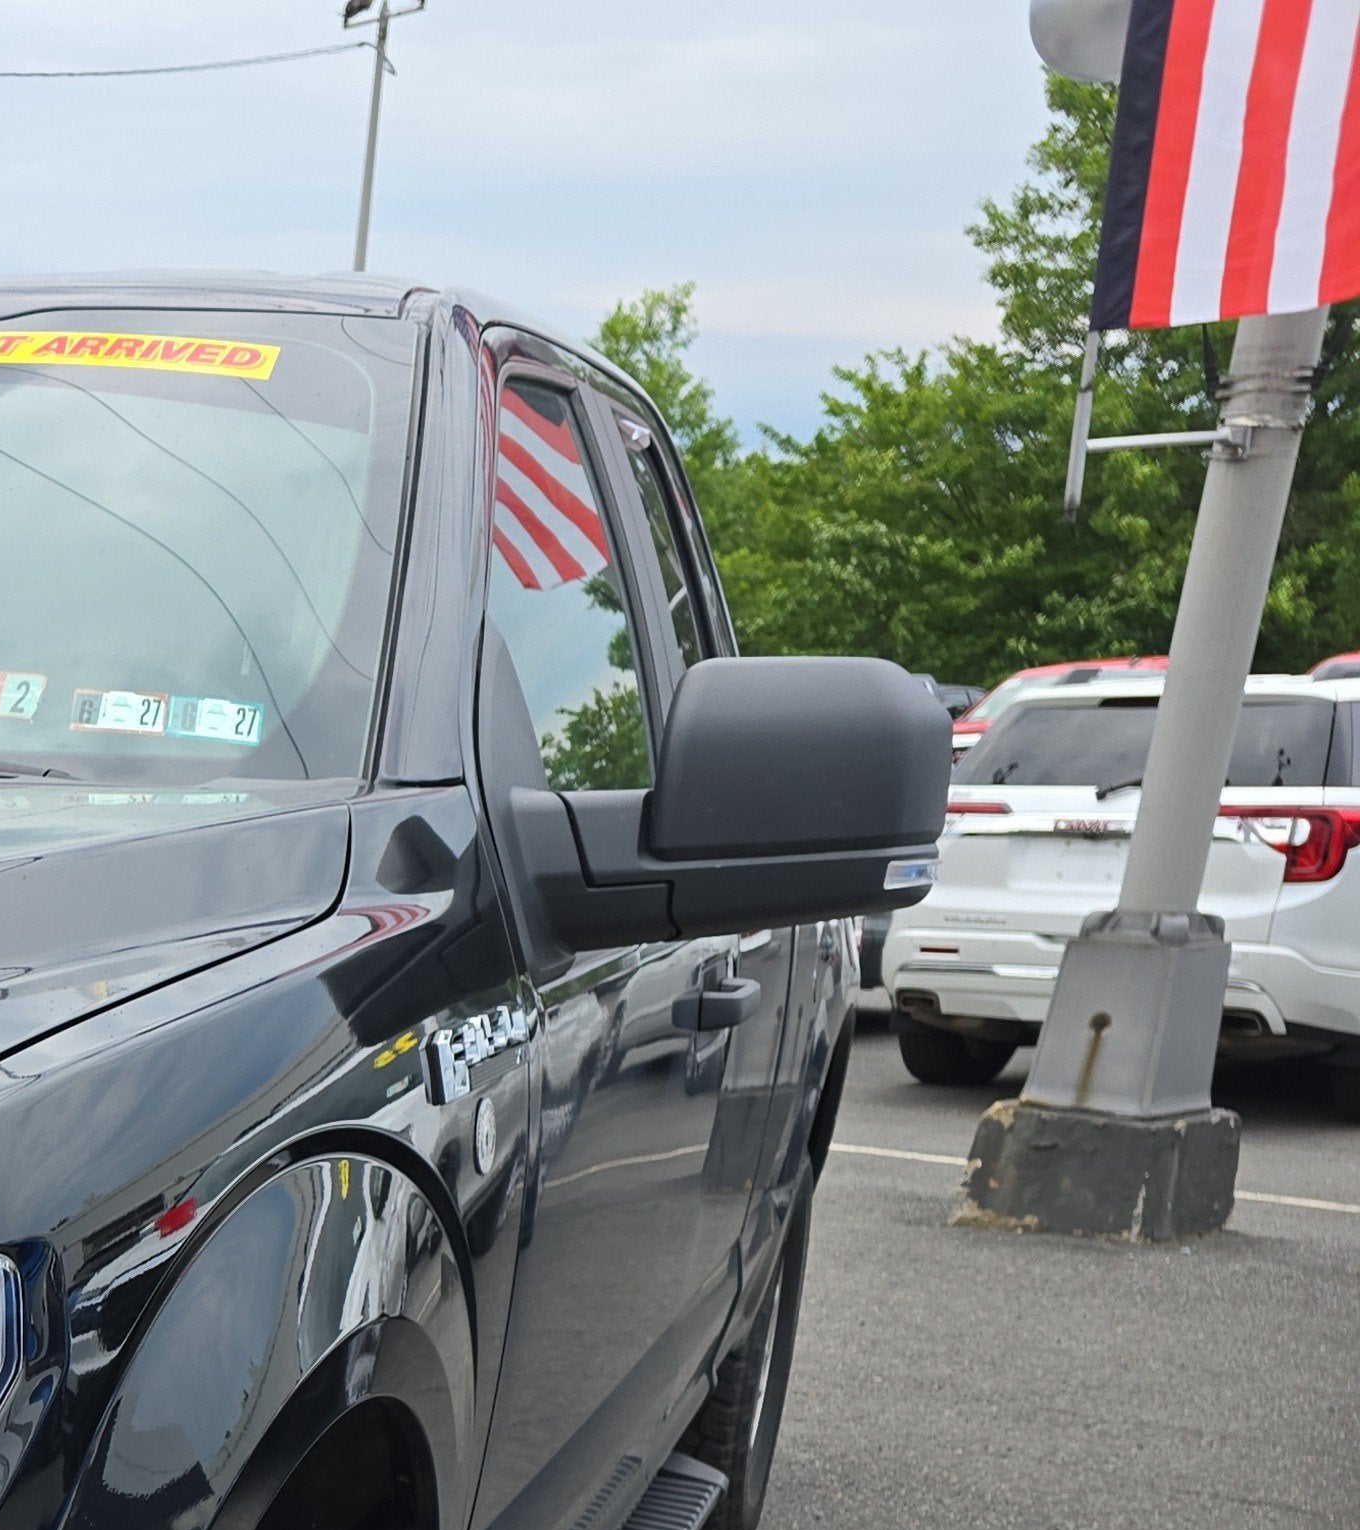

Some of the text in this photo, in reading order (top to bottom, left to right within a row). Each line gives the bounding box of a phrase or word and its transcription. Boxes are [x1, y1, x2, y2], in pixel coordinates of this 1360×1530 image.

[31, 336, 269, 370] ARRIVED
[9, 680, 32, 714] 2
[139, 698, 162, 728] 27
[234, 706, 258, 738] 27
